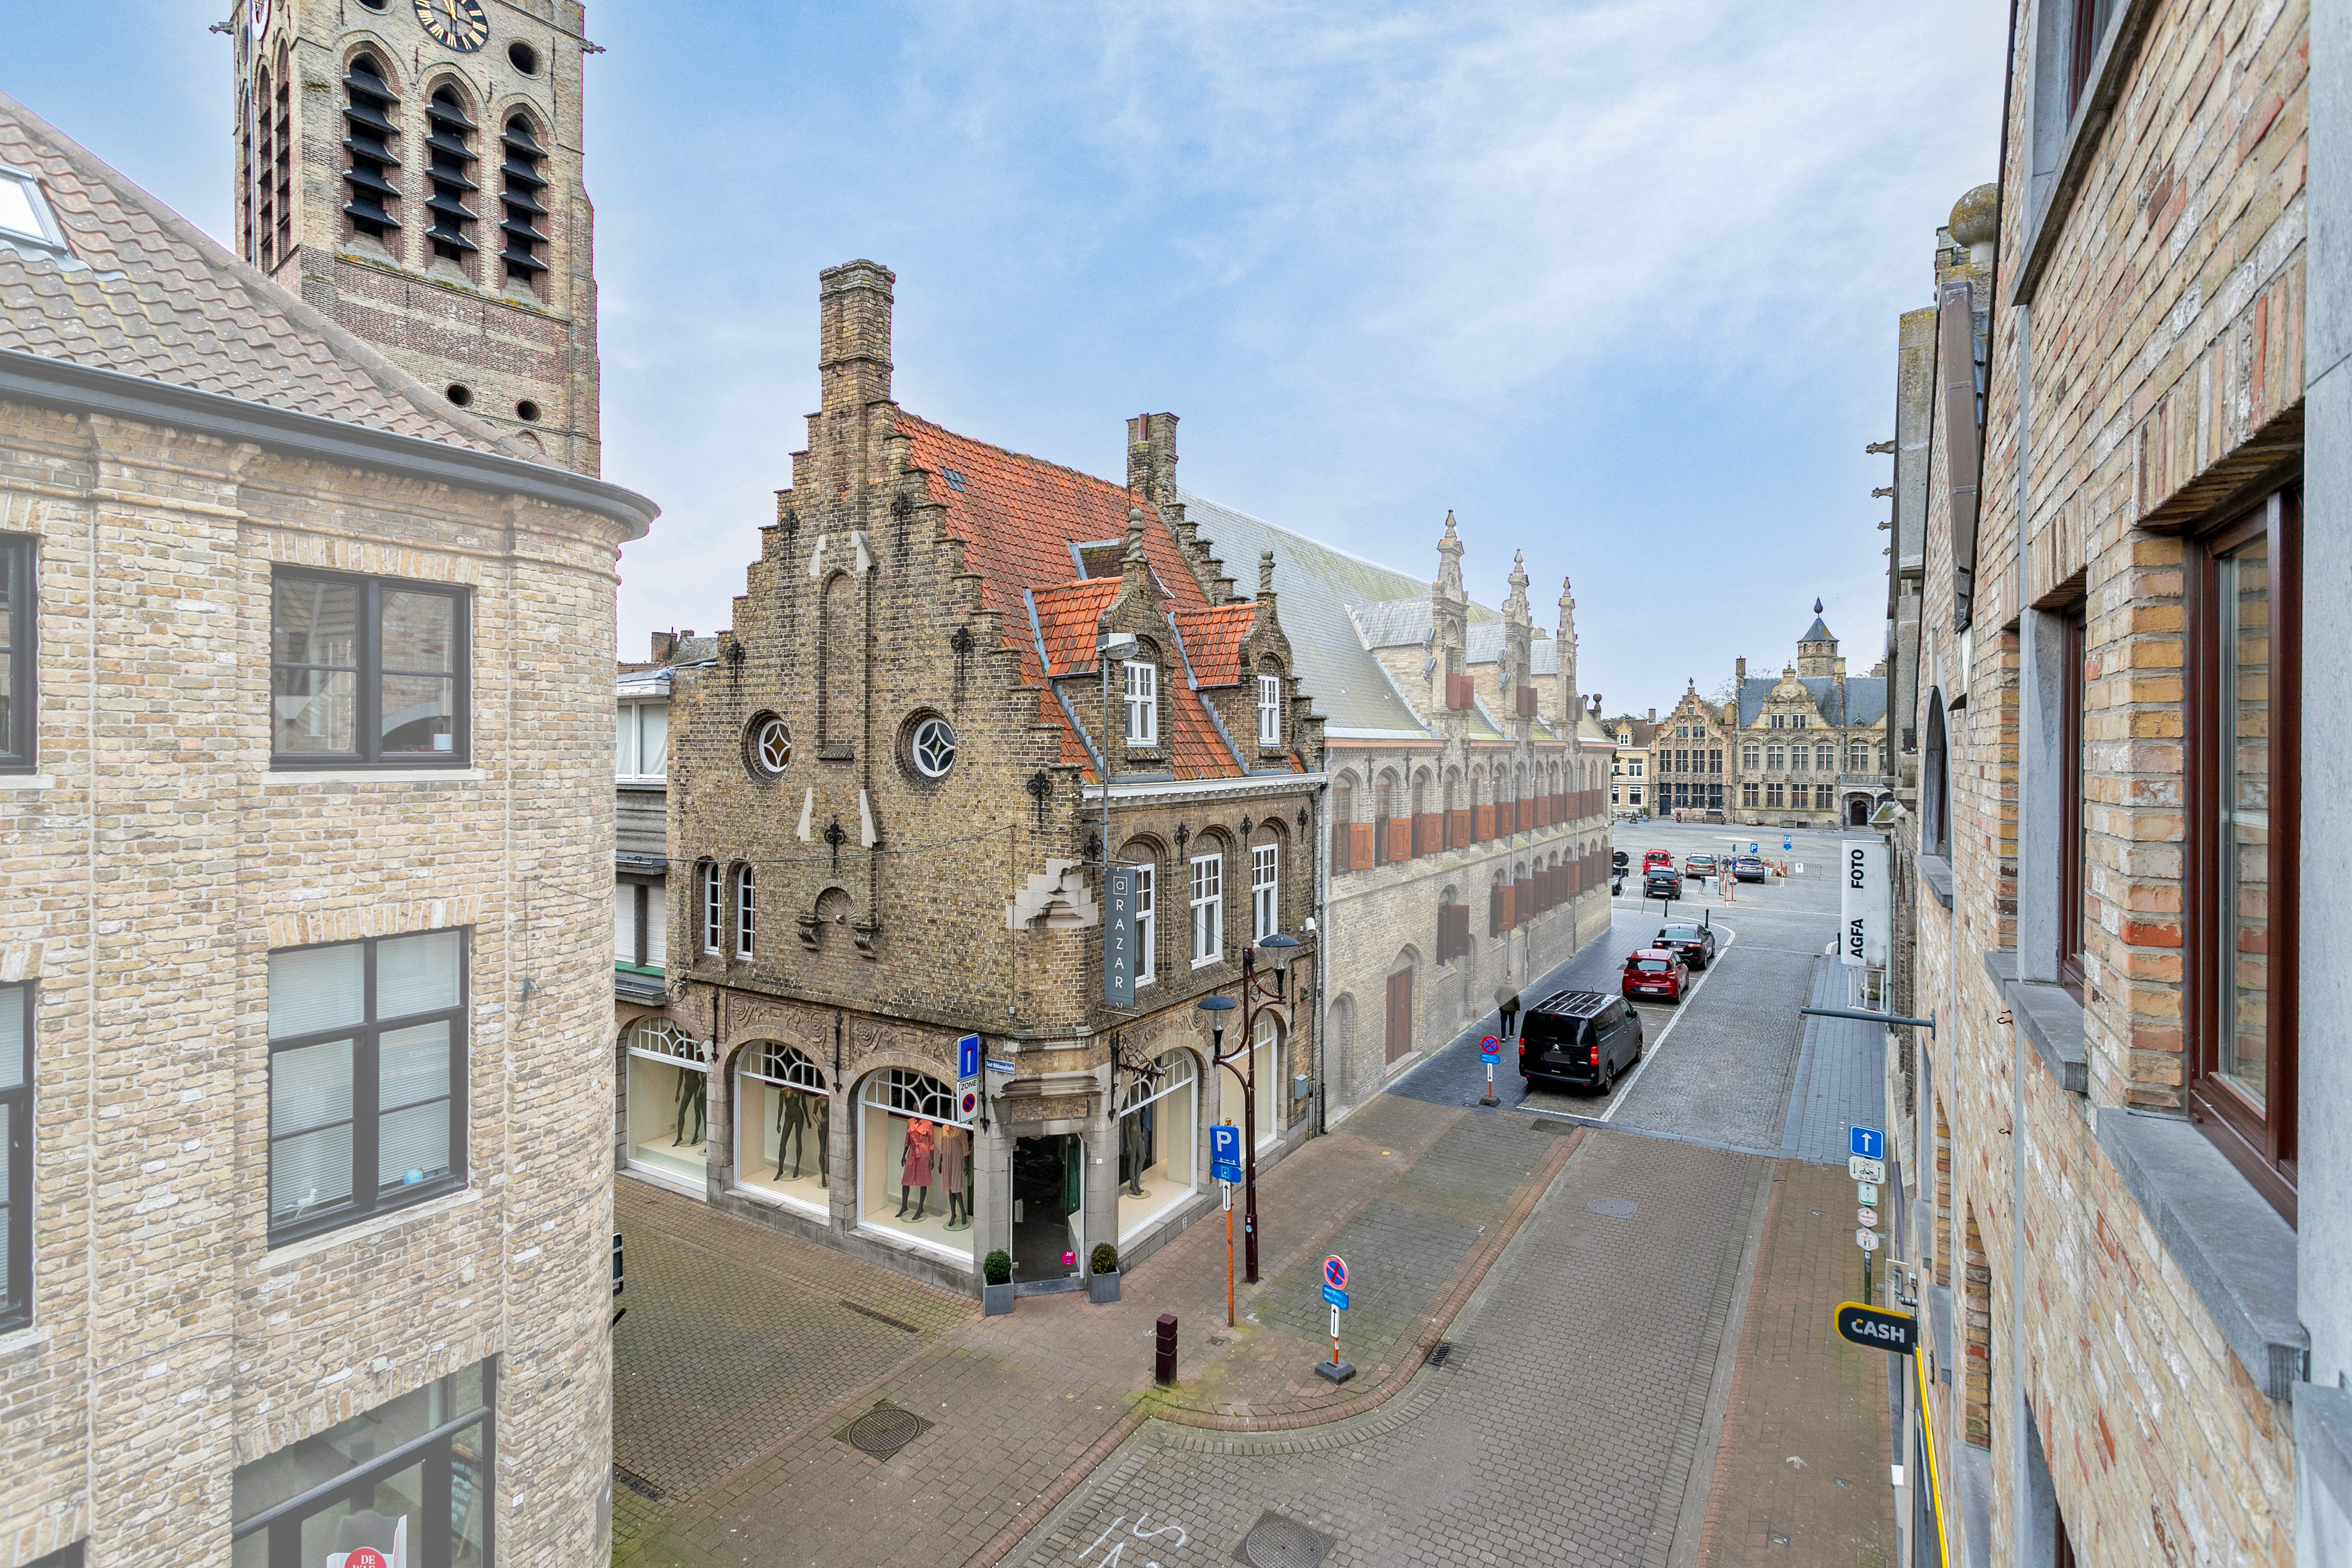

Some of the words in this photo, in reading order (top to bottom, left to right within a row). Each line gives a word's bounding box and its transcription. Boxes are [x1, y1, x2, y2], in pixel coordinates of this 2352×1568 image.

[1851, 849, 1864, 889] FOTO
[1851, 918, 1863, 959] AGFA
[961, 1079, 977, 1091] ZONE
[1216, 1131, 1232, 1152] P
[1851, 1319, 1905, 1343] CASH
[361, 1554, 375, 1565] DE
